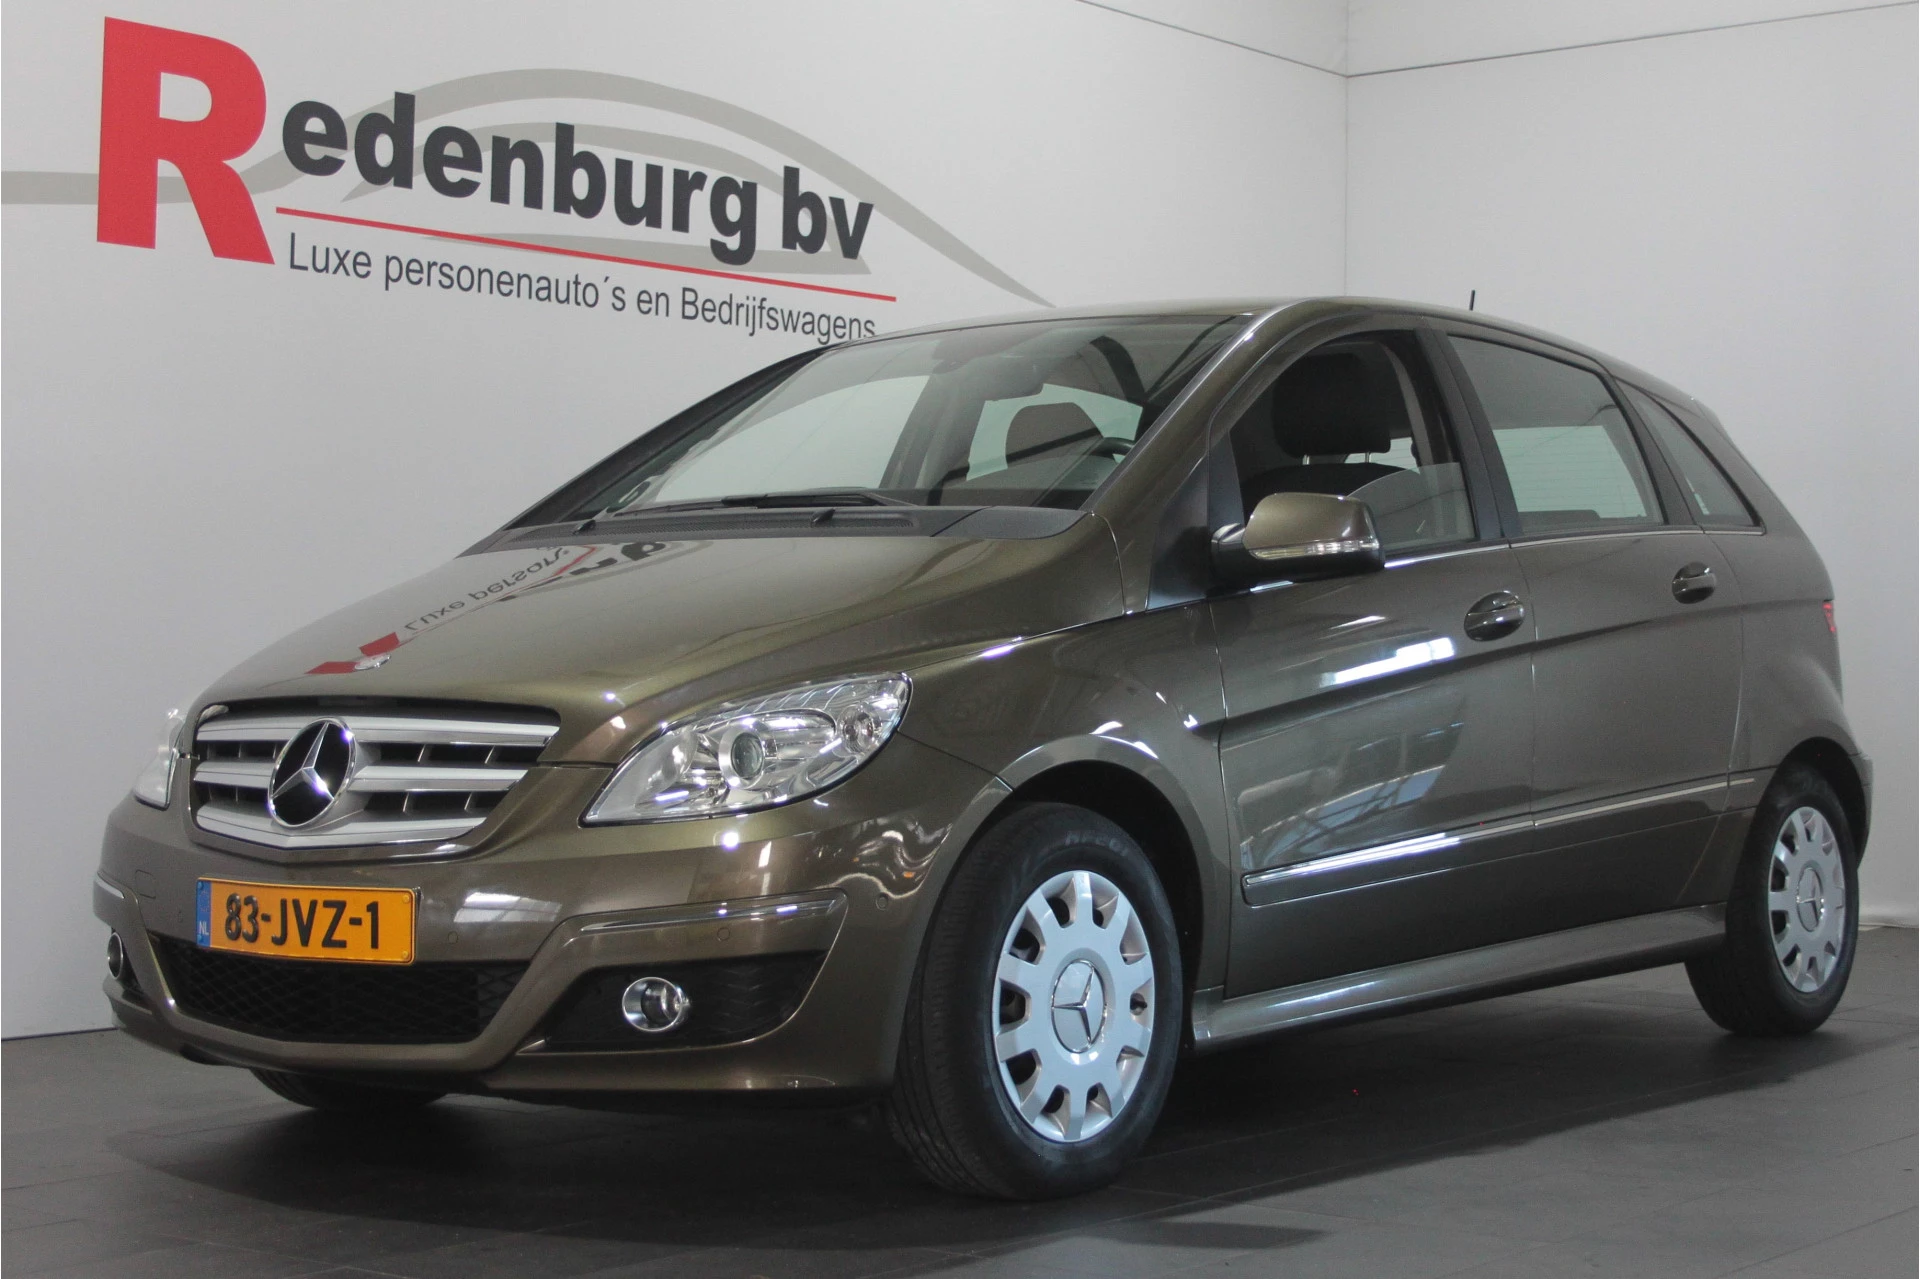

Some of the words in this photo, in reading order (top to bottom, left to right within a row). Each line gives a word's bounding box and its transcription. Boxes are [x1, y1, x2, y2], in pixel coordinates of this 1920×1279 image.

[97, 16, 757, 265] Redenburg
[782, 165, 874, 260] bv
[290, 232, 371, 278] Luxe
[637, 289, 669, 317] en
[682, 287, 875, 345] Bedrijfswagens
[199, 921, 210, 936] NL
[225, 893, 379, 949] 83-JVZ-1
